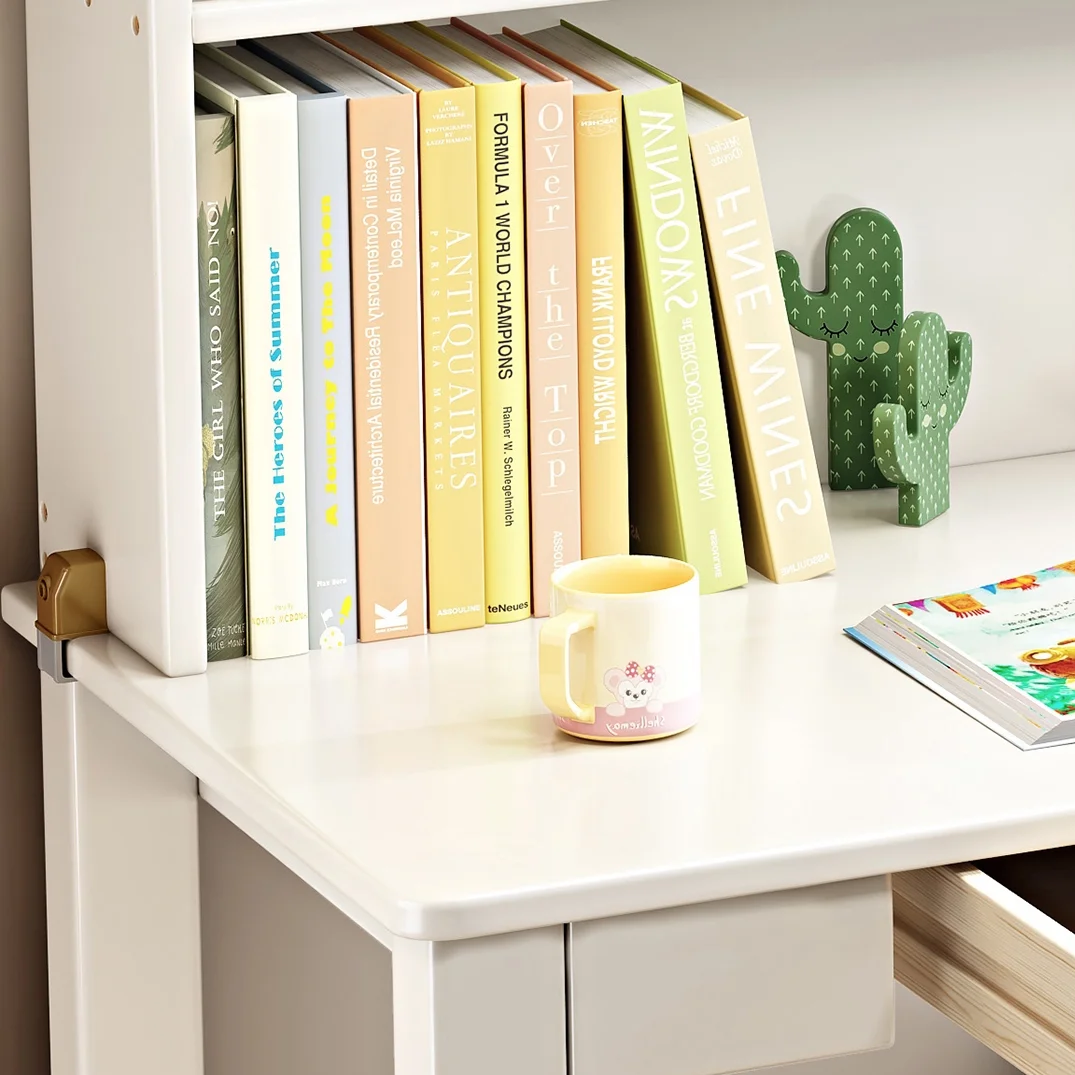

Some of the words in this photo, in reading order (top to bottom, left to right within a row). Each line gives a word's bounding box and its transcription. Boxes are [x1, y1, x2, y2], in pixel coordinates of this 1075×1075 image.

[493, 112, 509, 195] FORMULA
[495, 212, 511, 275] WORLD
[208, 257, 221, 317] SAID
[269, 247, 282, 362] Summer
[210, 325, 223, 390] WHO
[441, 227, 477, 490] ANTIQUAIRES
[496, 279, 513, 379] CHAMPIONS
[270, 368, 283, 393] of
[212, 400, 225, 461] GIRL
[273, 399, 285, 485] Heroes
[503, 406, 513, 438] Rainer
[503, 441, 513, 455] W.
[544, 384, 567, 488] Top
[213, 469, 225, 521] THE
[274, 491, 286, 541] The
[325, 503, 338, 527] A
[502, 456, 514, 527] Schlegelmilch
[487, 601, 529, 613] teNeues
